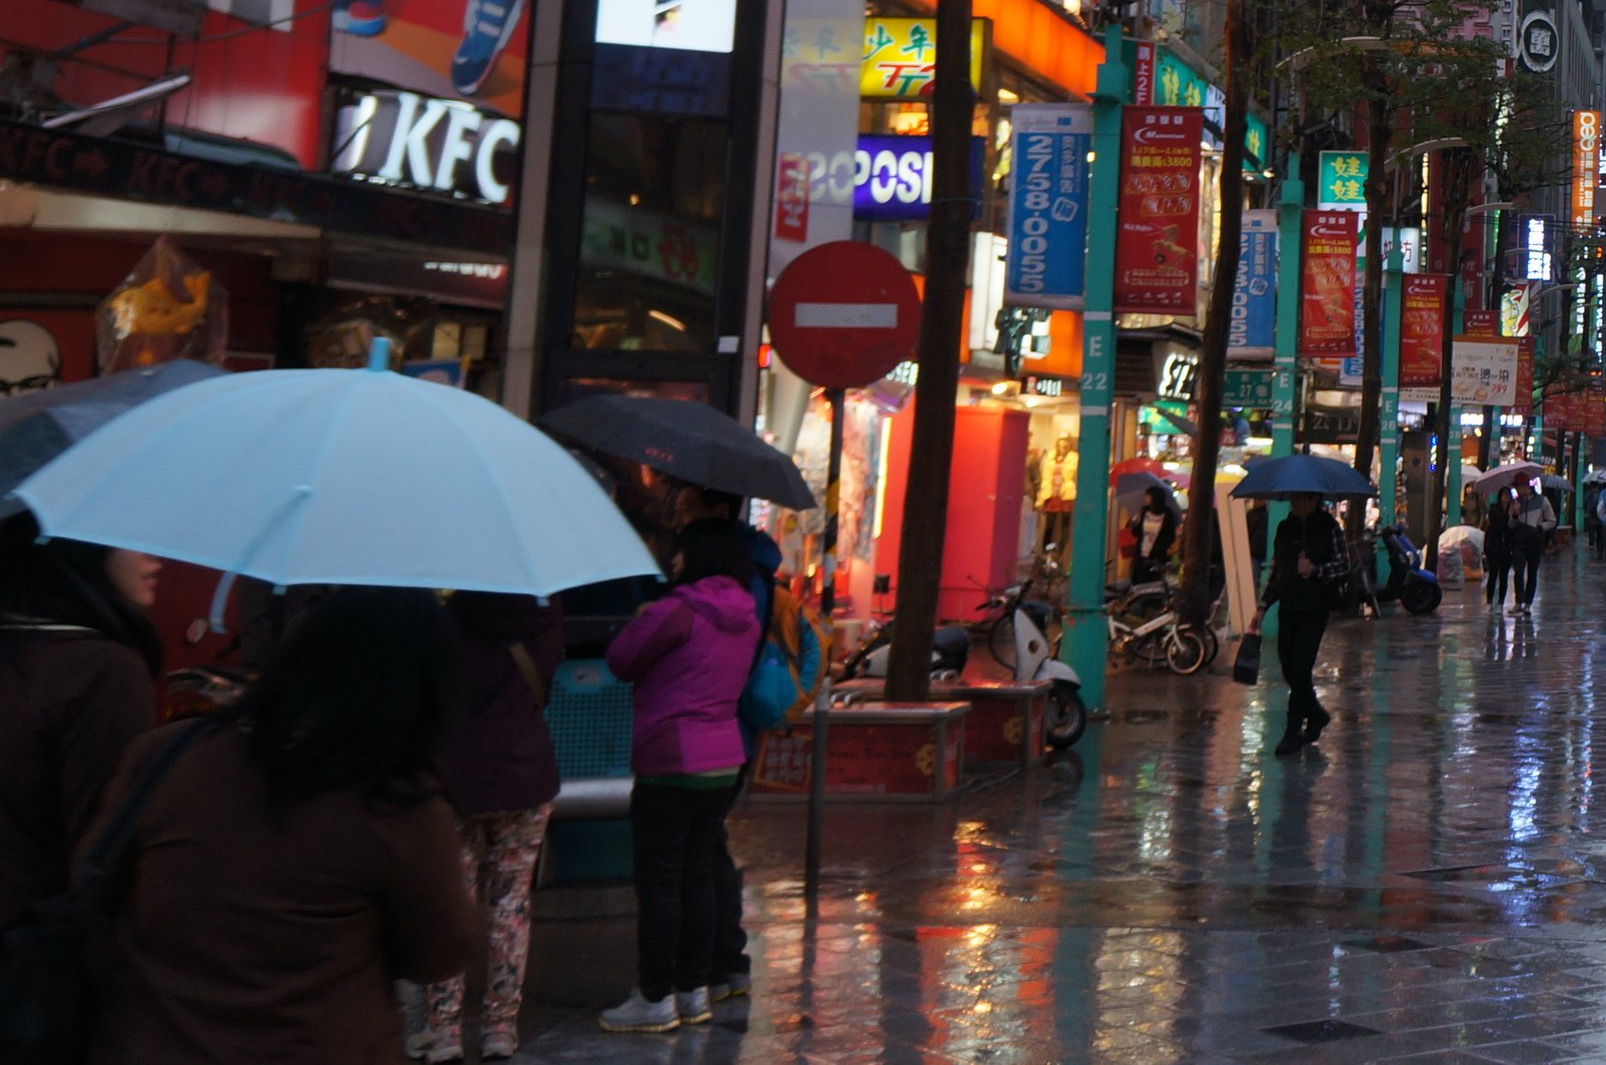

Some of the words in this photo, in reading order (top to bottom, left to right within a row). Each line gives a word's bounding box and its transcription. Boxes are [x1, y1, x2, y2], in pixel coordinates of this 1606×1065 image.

[379, 92, 520, 203] KFC
[1088, 336, 1102, 357] E
[1077, 372, 1107, 390] 22
[1279, 373, 1289, 388] E
